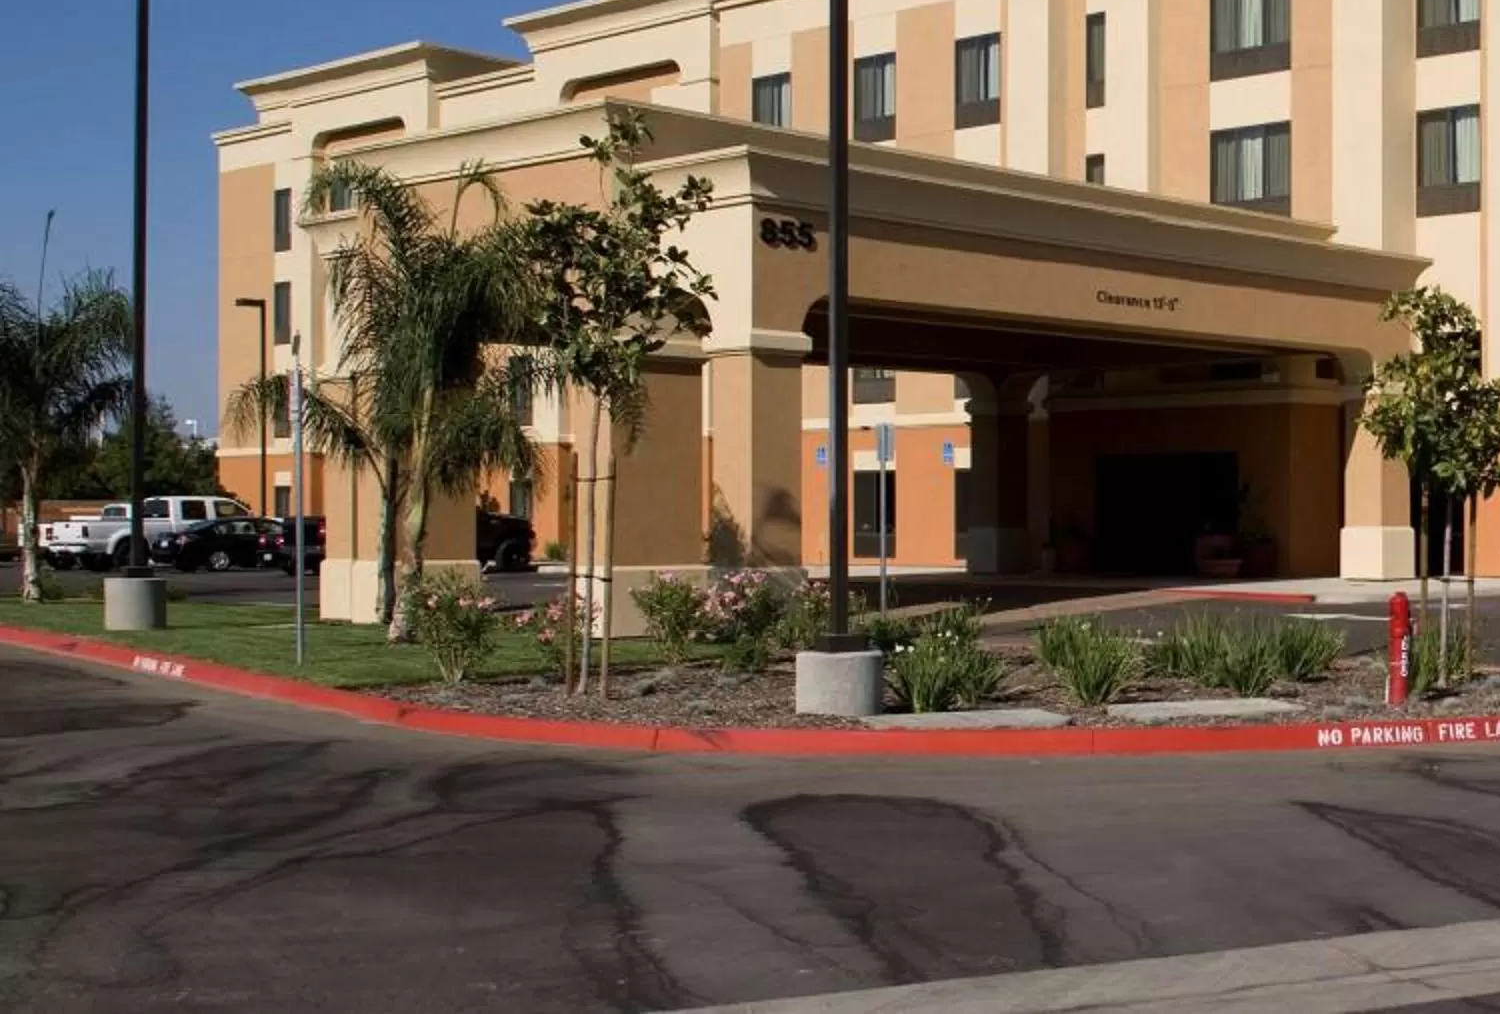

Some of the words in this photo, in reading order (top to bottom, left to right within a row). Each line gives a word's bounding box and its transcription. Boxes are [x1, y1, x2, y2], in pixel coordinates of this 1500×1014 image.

[760, 217, 818, 252] 855
[1317, 728, 1343, 746] NO
[1351, 726, 1423, 744] PARKING
[1438, 722, 1476, 741] FIRE
